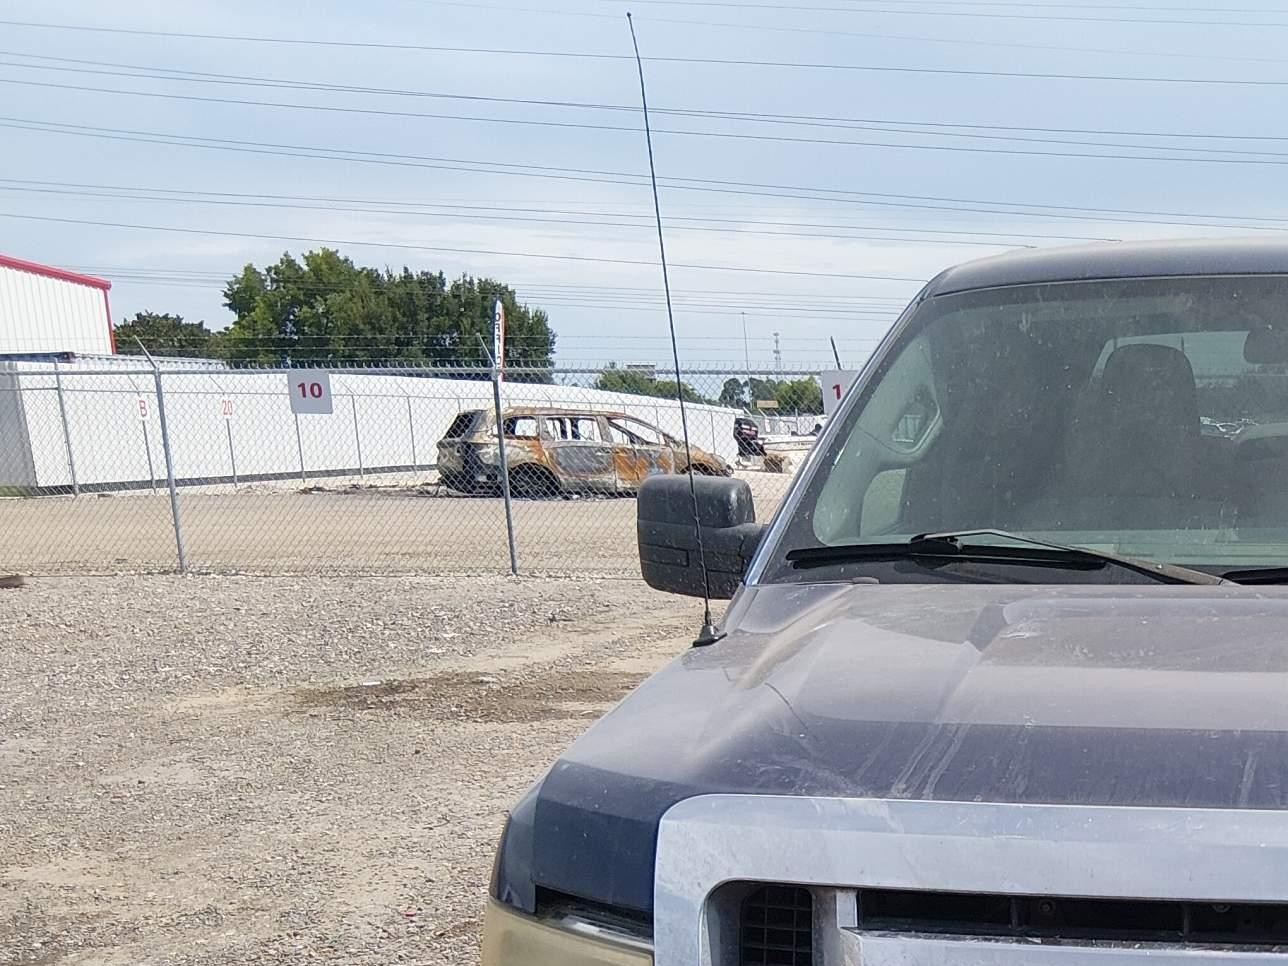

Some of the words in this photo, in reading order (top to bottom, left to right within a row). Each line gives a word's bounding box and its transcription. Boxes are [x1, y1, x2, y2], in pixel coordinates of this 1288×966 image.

[297, 382, 323, 399] 10
[833, 384, 842, 400] 1
[139, 400, 148, 417] B
[222, 400, 233, 415] 20
